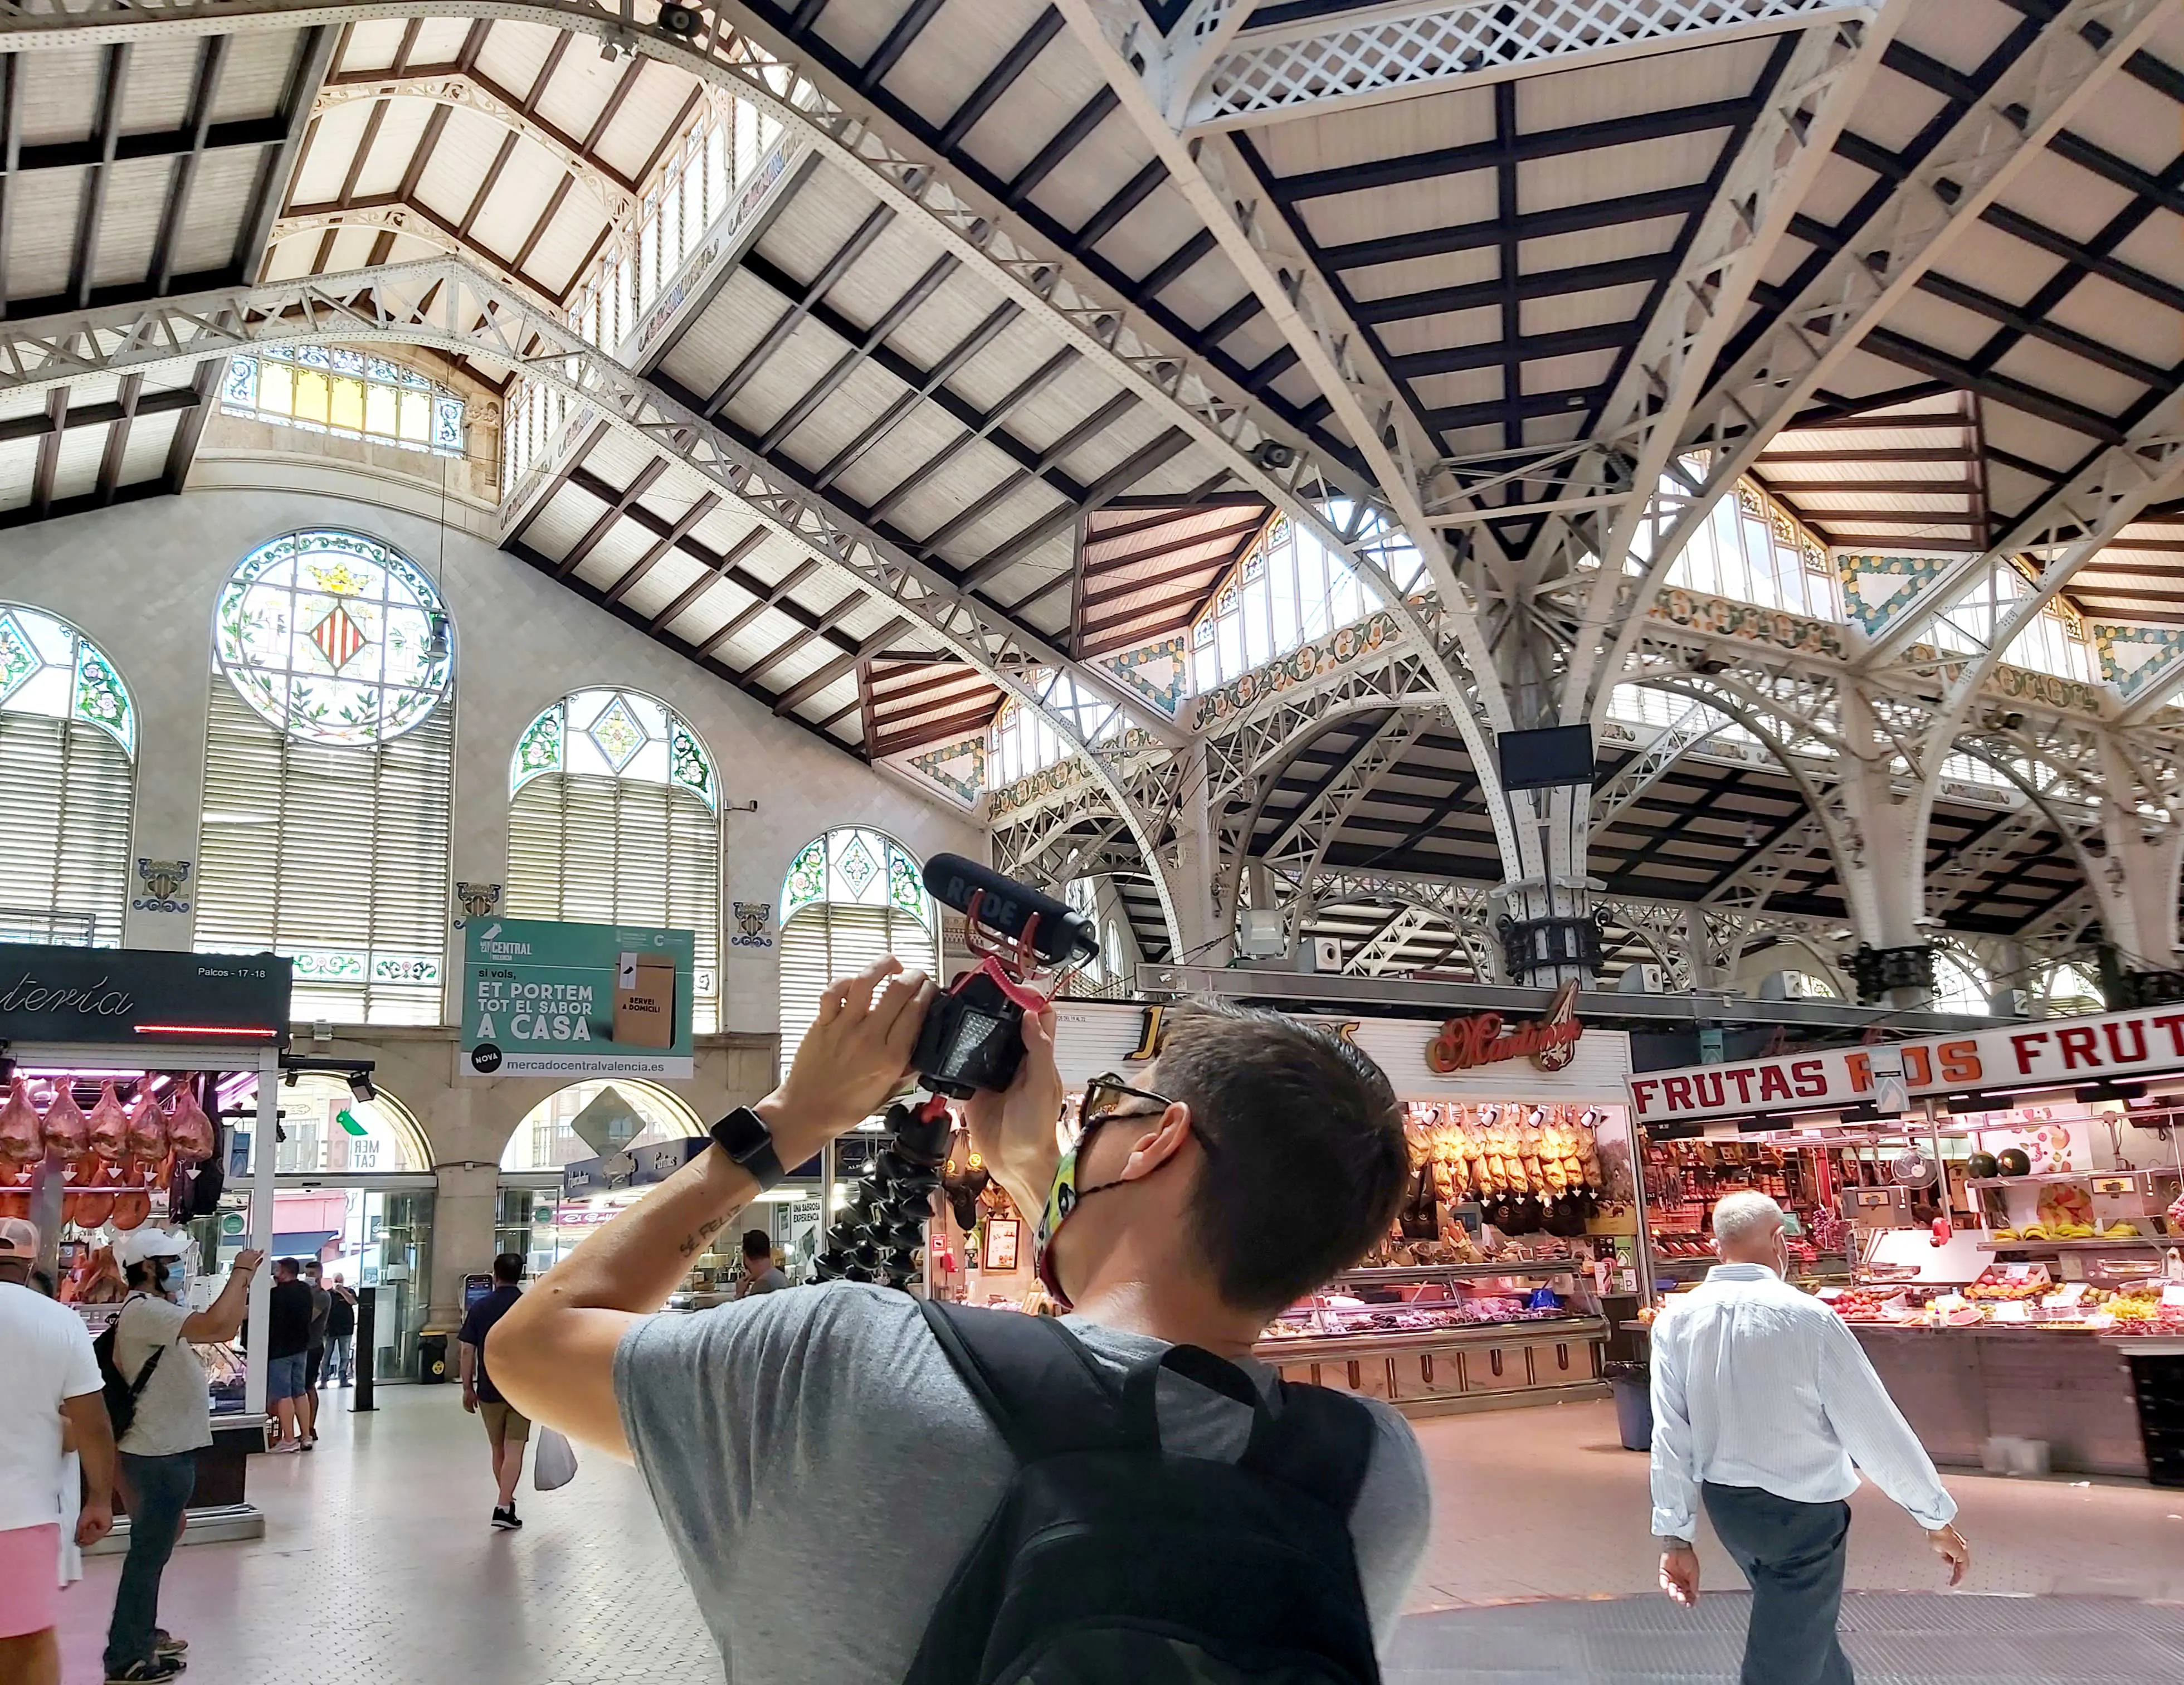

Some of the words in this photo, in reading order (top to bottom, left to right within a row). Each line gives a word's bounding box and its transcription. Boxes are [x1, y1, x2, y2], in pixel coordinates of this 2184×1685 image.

[492, 942, 532, 954] CENTRAL
[198, 967, 229, 977] Palcos
[479, 968, 488, 977] si
[491, 969, 516, 980] vols,
[479, 981, 503, 997] ET
[510, 982, 593, 1001] PORTEM
[477, 999, 510, 1012] TOT
[515, 1000, 533, 1013] EL
[539, 1001, 592, 1015] SABOR
[630, 997, 655, 1005] SERVEI
[629, 1004, 660, 1013] DOMICILI
[476, 1013, 496, 1039] A
[510, 1014, 591, 1041] CASA
[475, 1052, 498, 1064] NOVA
[1631, 1060, 1828, 1114] FRUTAS
[2009, 1014, 2184, 1075] FRUT
[507, 1060, 664, 1072] mercadocentralvalencia.es
[699, 1204, 740, 1239] FELIZ
[793, 1212, 820, 1223] EXPERIENCIA
